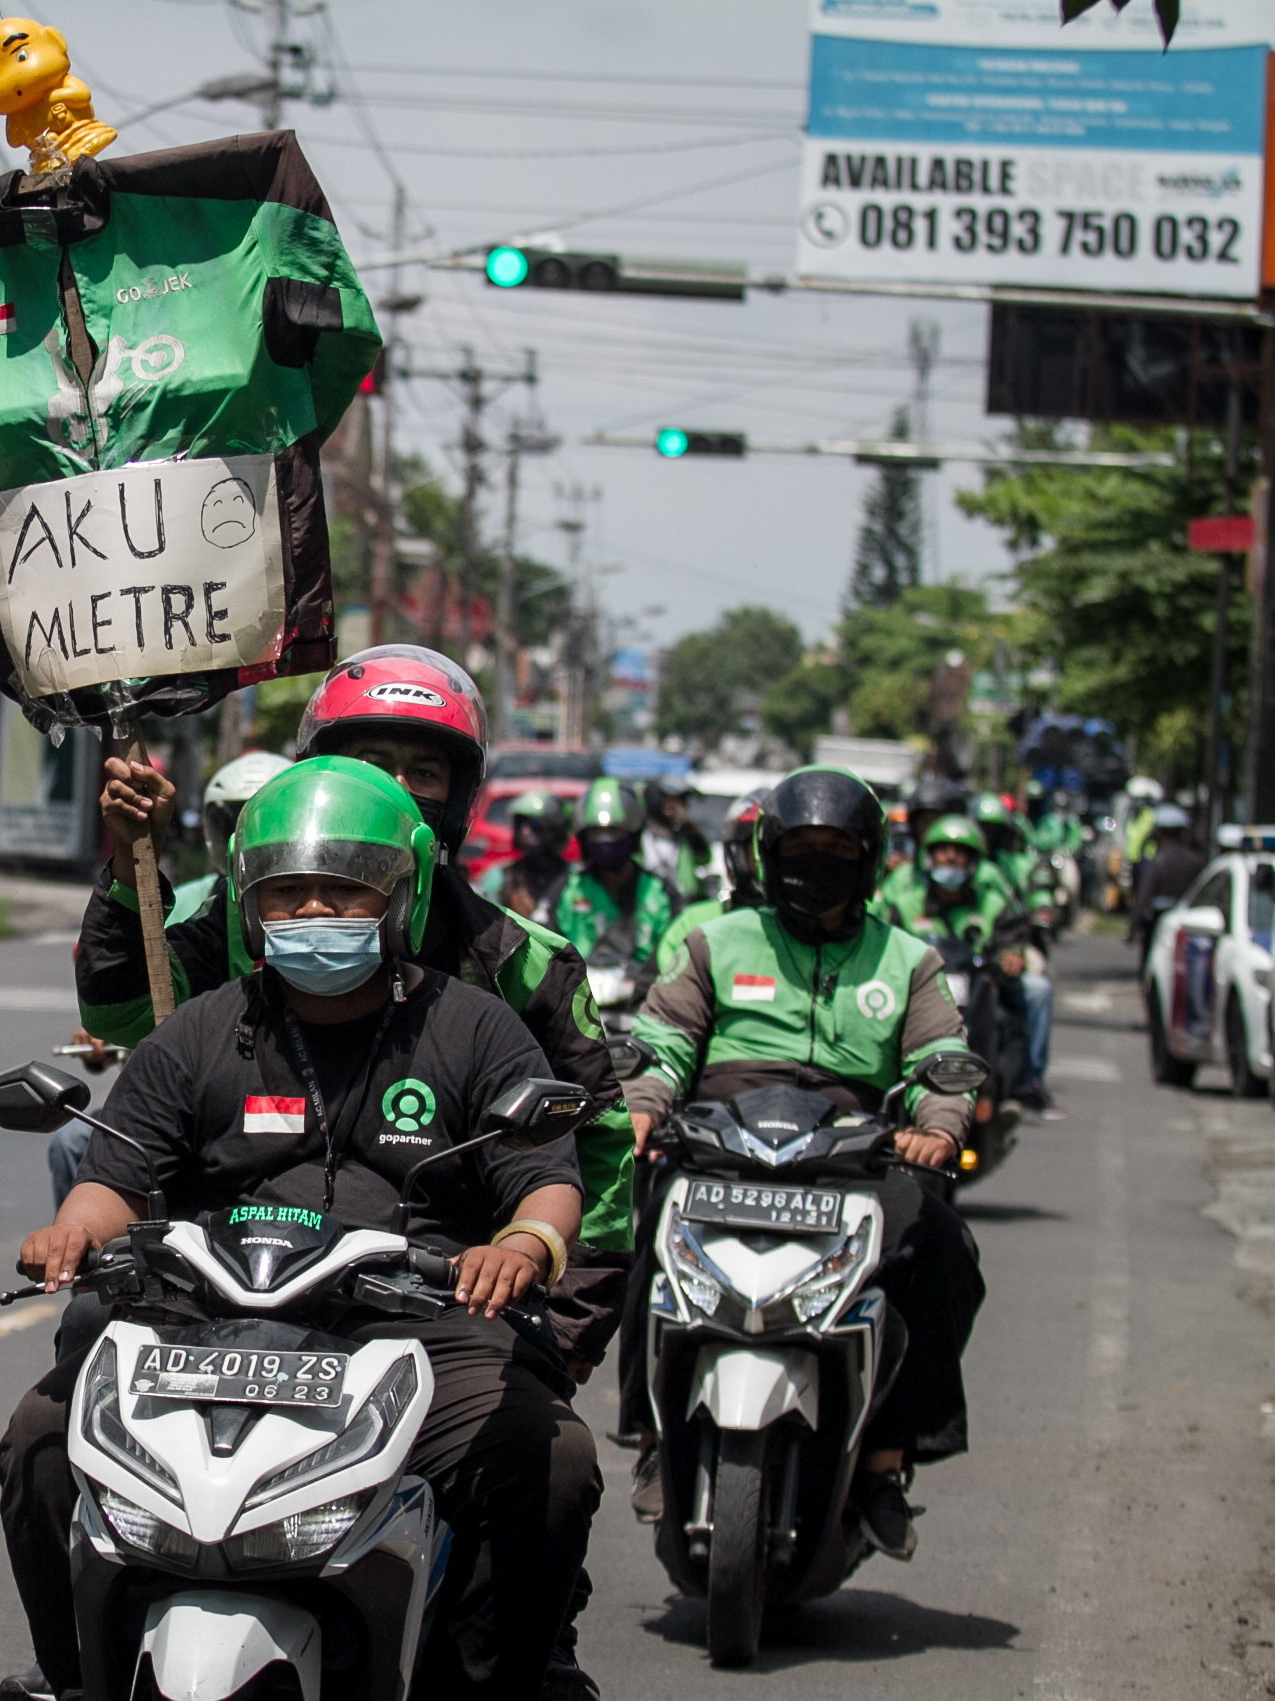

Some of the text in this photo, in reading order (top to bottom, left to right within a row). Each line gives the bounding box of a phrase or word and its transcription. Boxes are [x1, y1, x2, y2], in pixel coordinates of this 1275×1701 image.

[821, 153, 1016, 196] AVAILABLE
[1027, 158, 1145, 201] SPACE
[859, 203, 1242, 266] 081 393 750 032
[116, 272, 193, 304] GO JEK
[7, 478, 166, 585] AKU
[25, 581, 232, 672] MLETRE
[377, 687, 437, 701] INK
[757, 1120, 799, 1131] HONDA
[379, 1134, 433, 1146] gopartner
[695, 1185, 725, 1203] AD
[228, 1206, 323, 1231] ASPAL HITAM
[240, 1236, 294, 1249] HONDA
[143, 1348, 339, 1381] AD 4019 ZS
